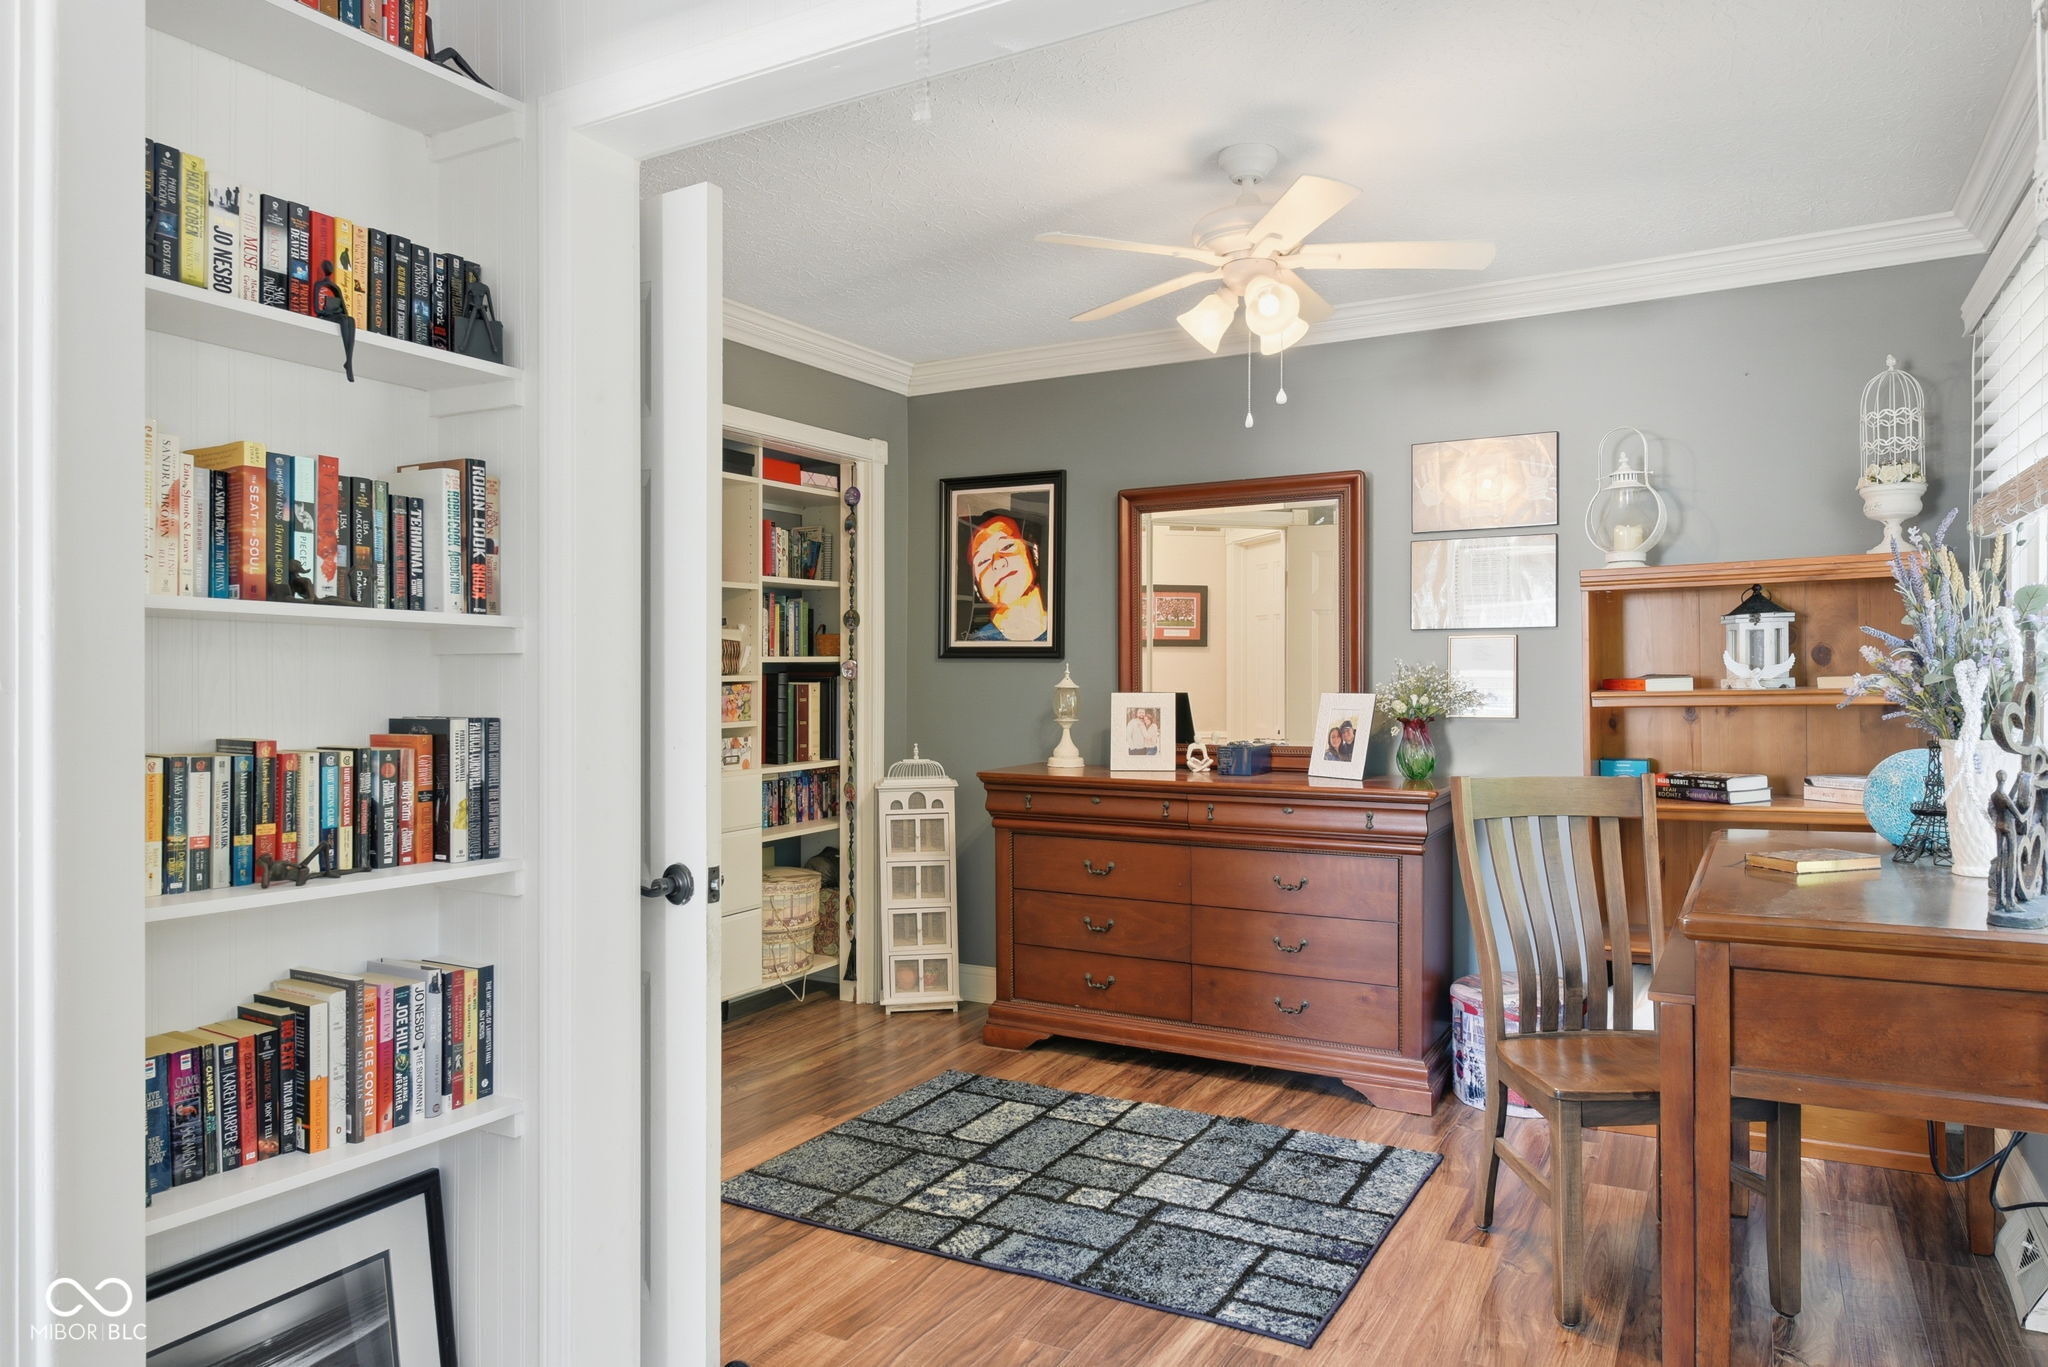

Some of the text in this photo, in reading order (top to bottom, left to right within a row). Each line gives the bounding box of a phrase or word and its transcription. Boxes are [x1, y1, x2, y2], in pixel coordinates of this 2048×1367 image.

[168, 177, 177, 204] PHILLIP
[186, 170, 201, 237] HARLAN COBEN
[162, 240, 171, 276] LOST LAKE
[213, 225, 233, 294] JO NESBO
[244, 235, 258, 270] MUSE
[290, 228, 300, 259] DEAVER
[300, 230, 310, 262] JEFFERY
[264, 276, 275, 306] PARETSK
[275, 287, 286, 304] SARA
[414, 262, 422, 296] LAYMON
[300, 284, 308, 314] PRAYIN
[435, 273, 444, 324] Body Work
[160, 440, 171, 538] SANDRA BROWN
[181, 490, 192, 518] Shoots
[250, 485, 259, 519] SEAT
[184, 522, 190, 530] &
[215, 490, 225, 546] SANDRA BROWN
[448, 490, 460, 546] ROBIN COOK
[472, 466, 486, 558] ROBIN COOK
[275, 523, 284, 552] STEPHEN
[410, 509, 422, 576] TERMINAL
[250, 538, 259, 574] SOUL
[448, 550, 460, 594] ABDUCTION
[216, 562, 225, 591] WITNESS
[472, 564, 486, 599] SHOCK
[262, 758, 270, 778] MARY
[470, 722, 481, 789] PATRICIA CORNWELL
[489, 722, 500, 786] PATRICIA CORNWELL
[174, 774, 183, 795] MARY
[327, 768, 335, 784] MARY
[1670, 778, 1688, 786] KOONTZ
[173, 798, 183, 815] JANE
[220, 781, 228, 849] MARY HIGGINS CLARK
[240, 791, 248, 814] HIGGINS
[262, 802, 270, 824] CLARK
[401, 780, 413, 821] Body Farm
[489, 788, 500, 848] THE LAST PRECINCT
[384, 806, 394, 857] THE LAST PRECINCT
[365, 1016, 374, 1040] THE
[396, 1002, 408, 1054] JOE HILL
[414, 986, 424, 1040] JO NESBO
[281, 1020, 294, 1070] NO EXIT
[365, 1046, 374, 1064] ICE
[175, 1074, 200, 1088] CLIVE
[206, 1066, 214, 1112] CLIVE BARKER
[223, 1071, 237, 1104] KAREN
[364, 1070, 374, 1116] COVEN
[416, 1052, 424, 1108] THE SNOWMAN
[264, 1102, 272, 1138] DON'T TELL
[284, 1079, 293, 1135] TAYLOR ADAMS
[223, 1105, 238, 1146] HARPER
[180, 1127, 197, 1168] SACRAMENT
